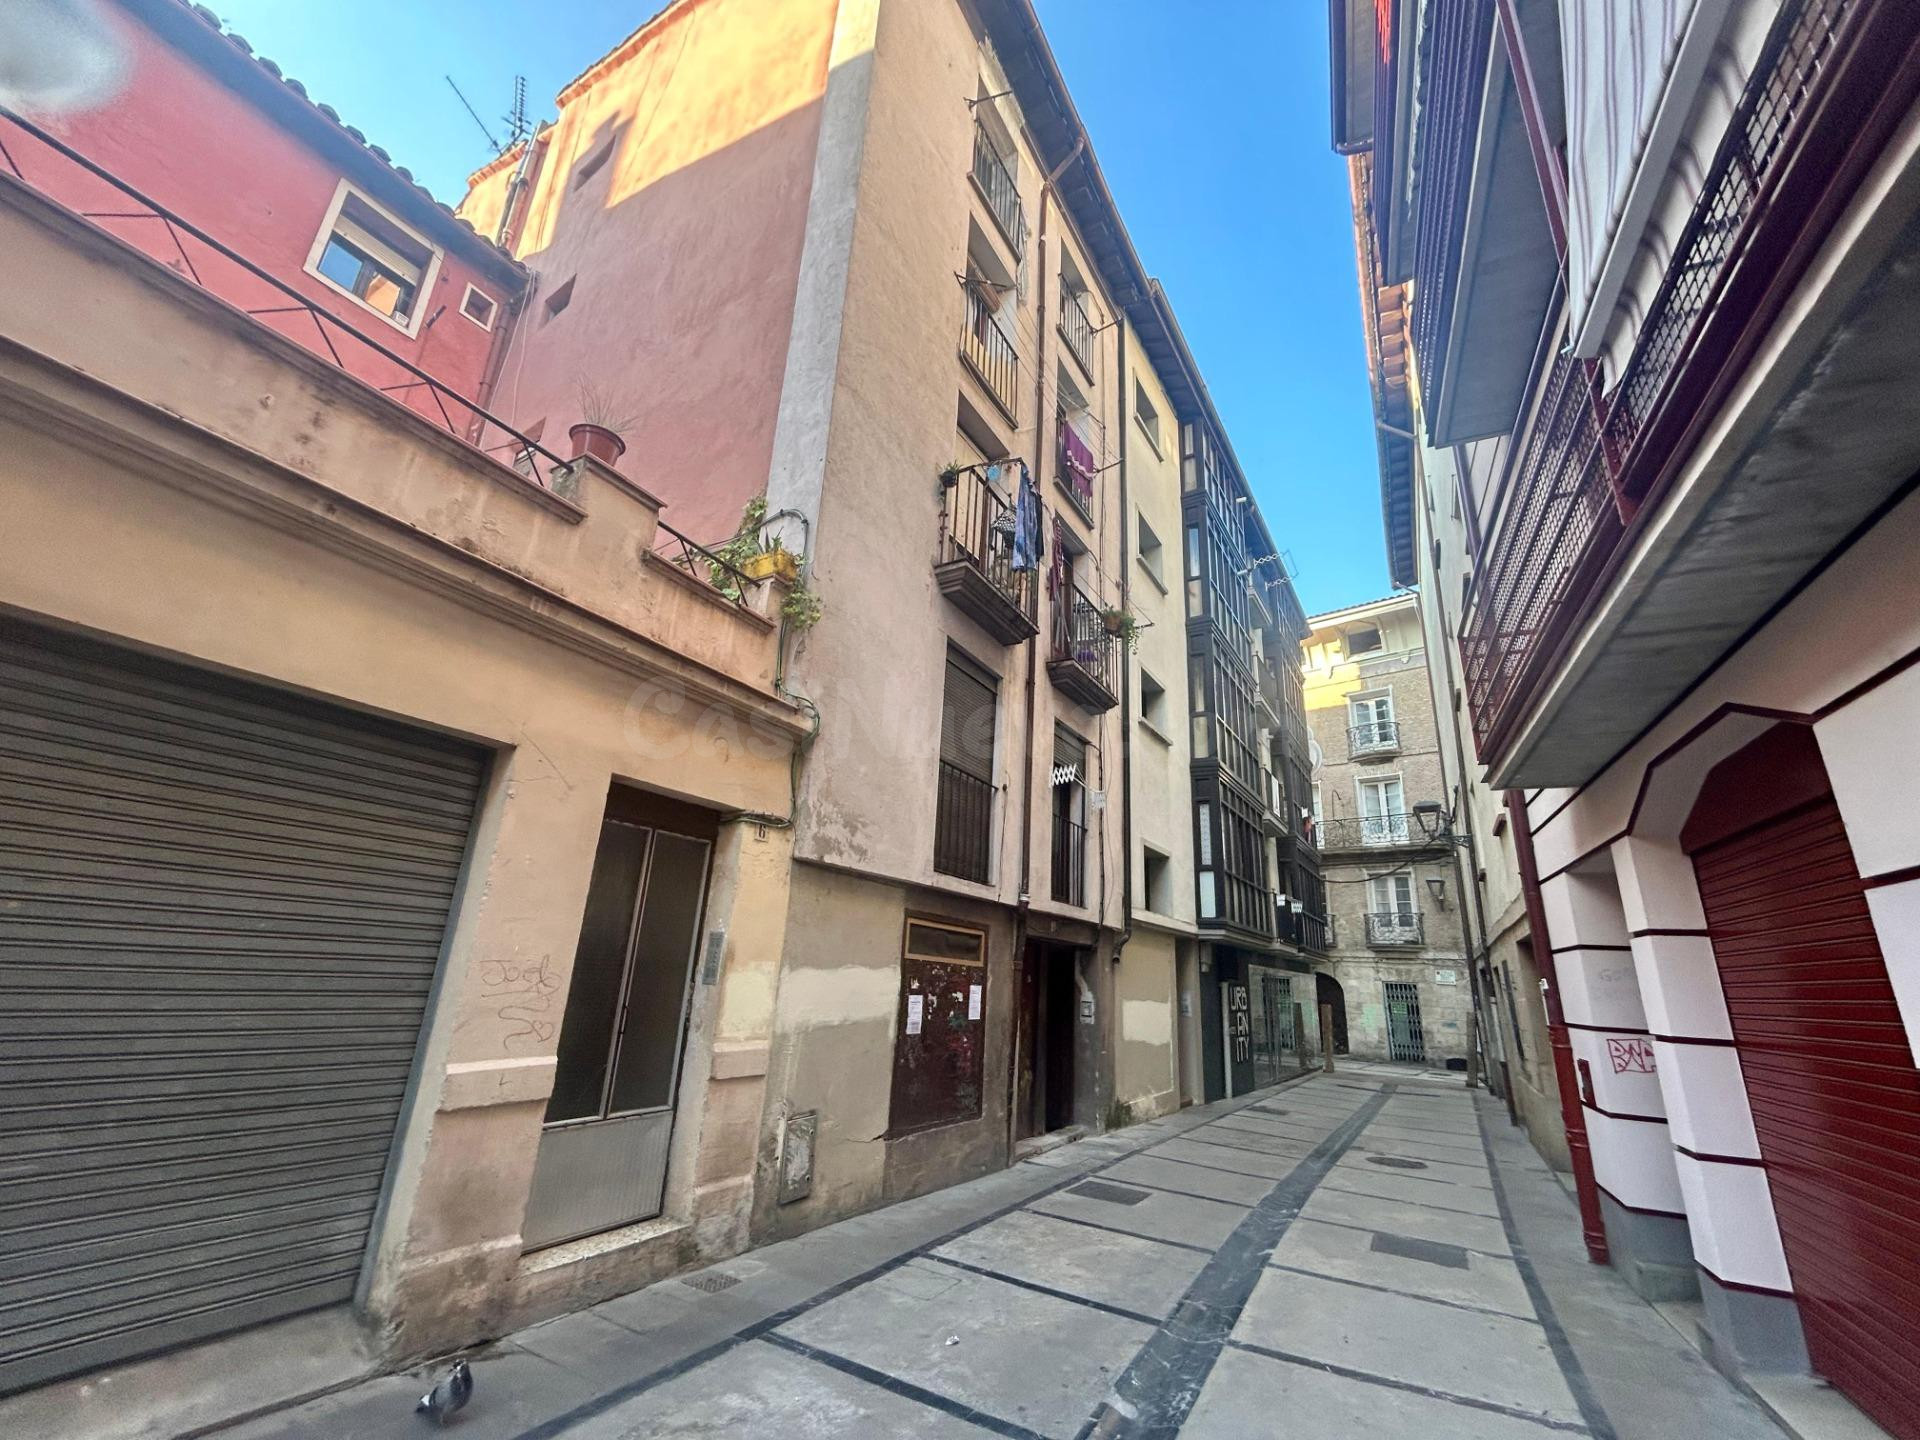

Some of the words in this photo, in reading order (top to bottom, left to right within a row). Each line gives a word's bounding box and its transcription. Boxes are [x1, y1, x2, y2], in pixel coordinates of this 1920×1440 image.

[759, 824, 766, 838] 6
[1230, 986, 1248, 1010] URB
[1237, 1011, 1249, 1036] AN
[1236, 1036, 1249, 1063] ITY
